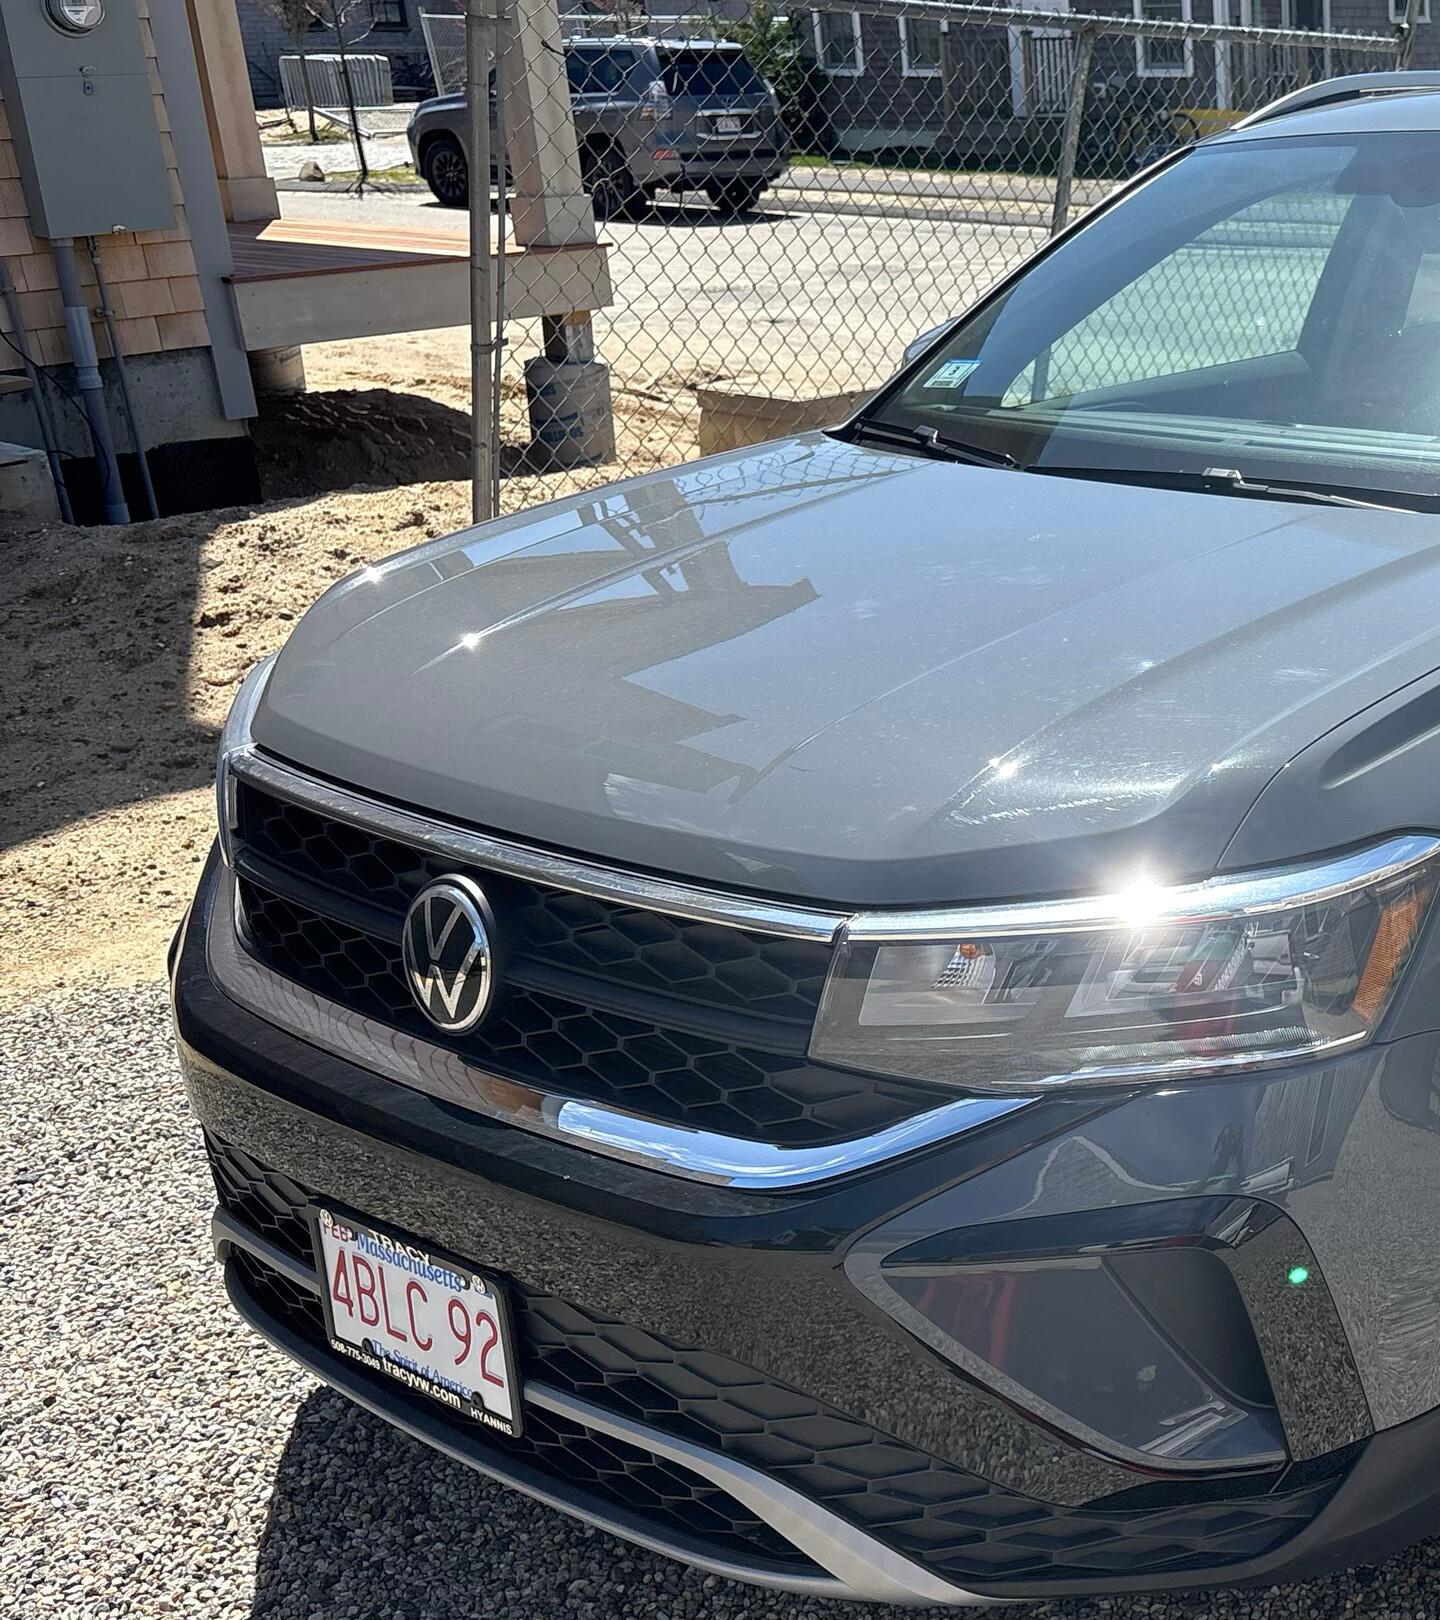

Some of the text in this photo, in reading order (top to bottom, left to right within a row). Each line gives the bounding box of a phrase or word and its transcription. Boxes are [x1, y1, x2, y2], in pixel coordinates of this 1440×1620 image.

[357, 1232, 462, 1292] Massachusetts
[368, 1228, 431, 1266] TRACY
[333, 1249, 504, 1388] 4BLC 92
[382, 1357, 461, 1408] tracyvw.com
[470, 1407, 513, 1435] HYANNIS
